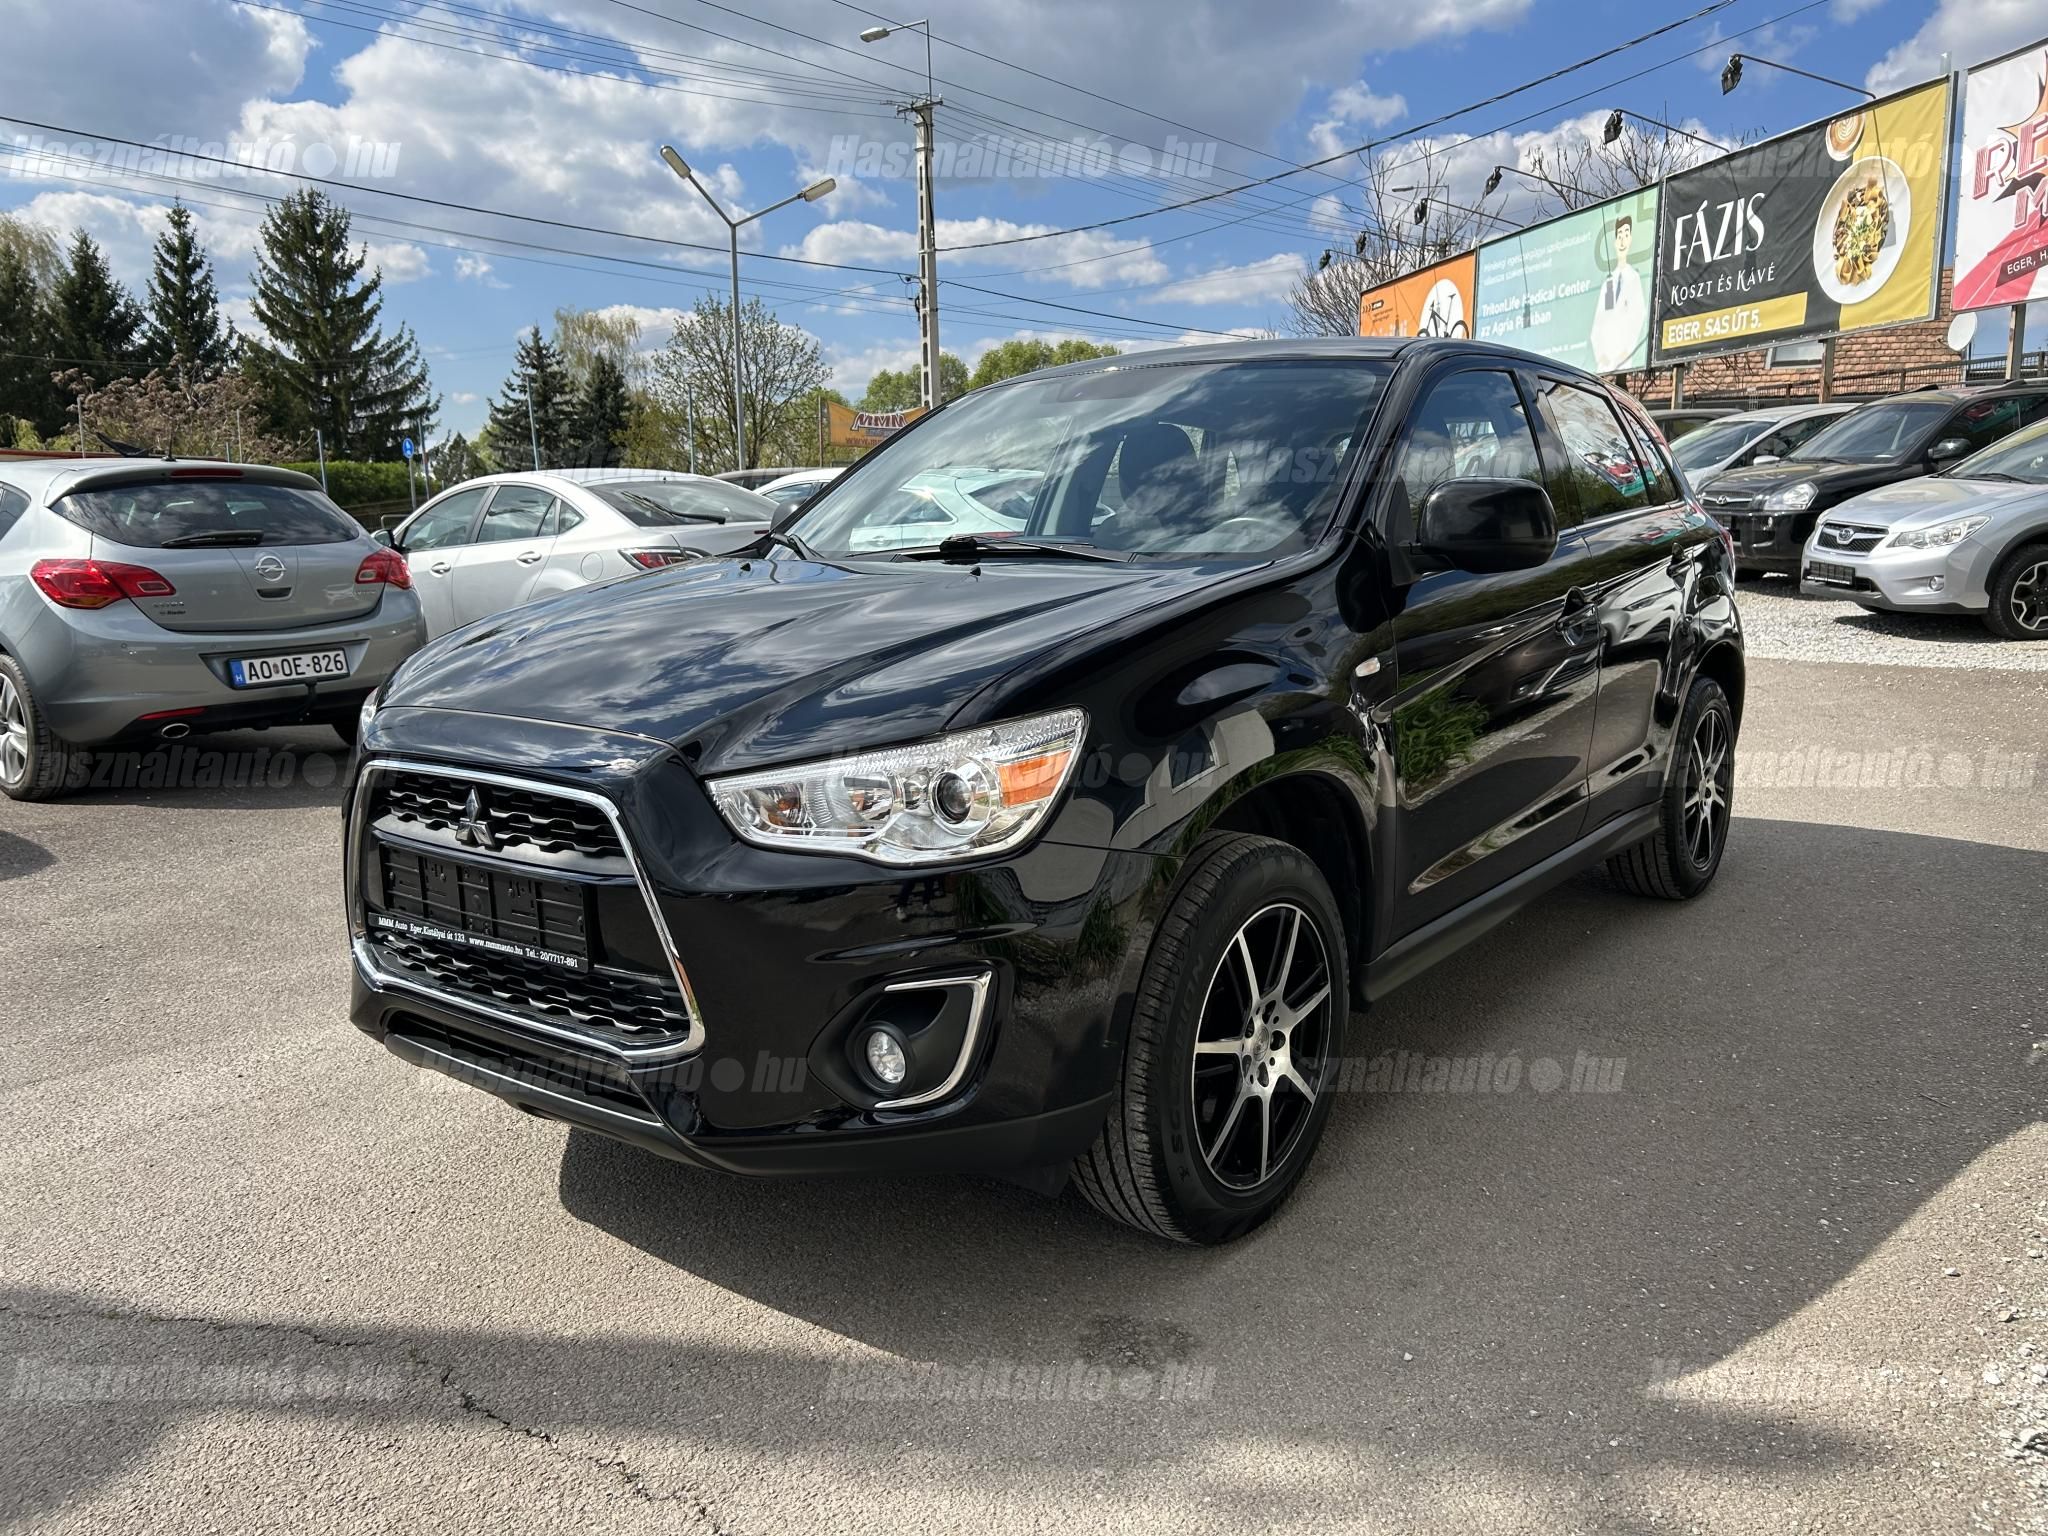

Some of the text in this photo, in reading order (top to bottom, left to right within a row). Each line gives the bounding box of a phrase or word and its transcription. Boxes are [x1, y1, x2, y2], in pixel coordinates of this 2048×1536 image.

[1673, 192, 1765, 271] FÁZIS
[1670, 261, 1776, 306] KOSZT ÉS KÁVÉ
[2007, 256, 2036, 275] EGER,
[1482, 279, 1591, 317] TritonLife Medical Center
[1668, 307, 1762, 344] EGER, SAS ÚT 5.
[378, 916, 394, 928] MMM
[395, 920, 408, 931] Auto
[469, 937, 523, 955] www.mmmauto.hu
